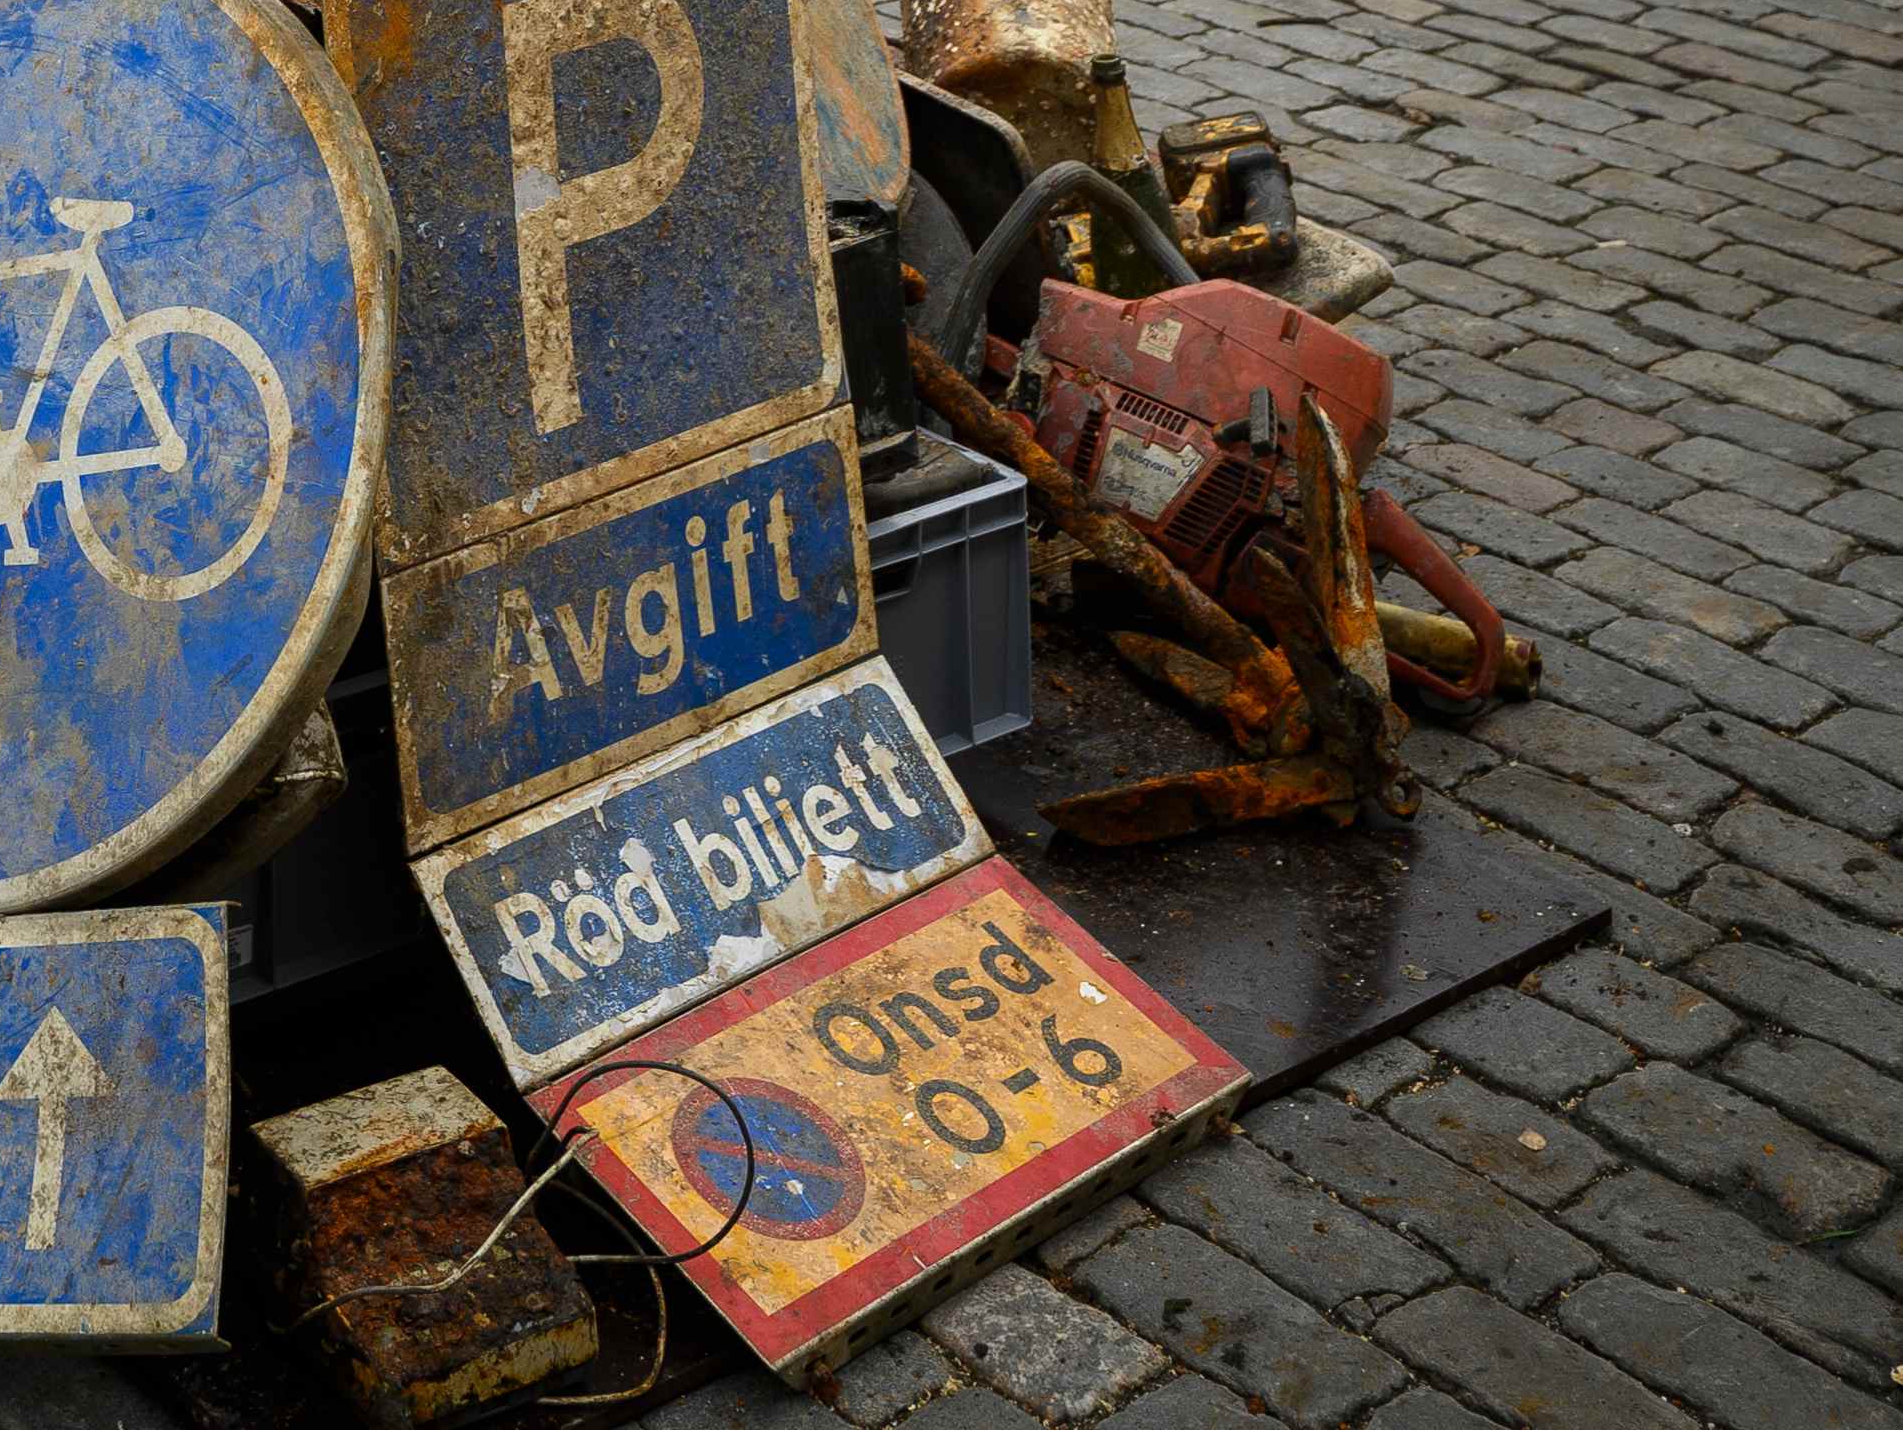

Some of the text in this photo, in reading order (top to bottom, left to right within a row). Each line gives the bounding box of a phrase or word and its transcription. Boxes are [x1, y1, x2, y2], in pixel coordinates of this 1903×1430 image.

[1120, 445, 1178, 479] Husqvarna
[489, 488, 800, 702] Avgift
[495, 731, 923, 998] Röd biljett
[812, 920, 1055, 1076] Onsd
[914, 1013, 1123, 1155] 0-6
